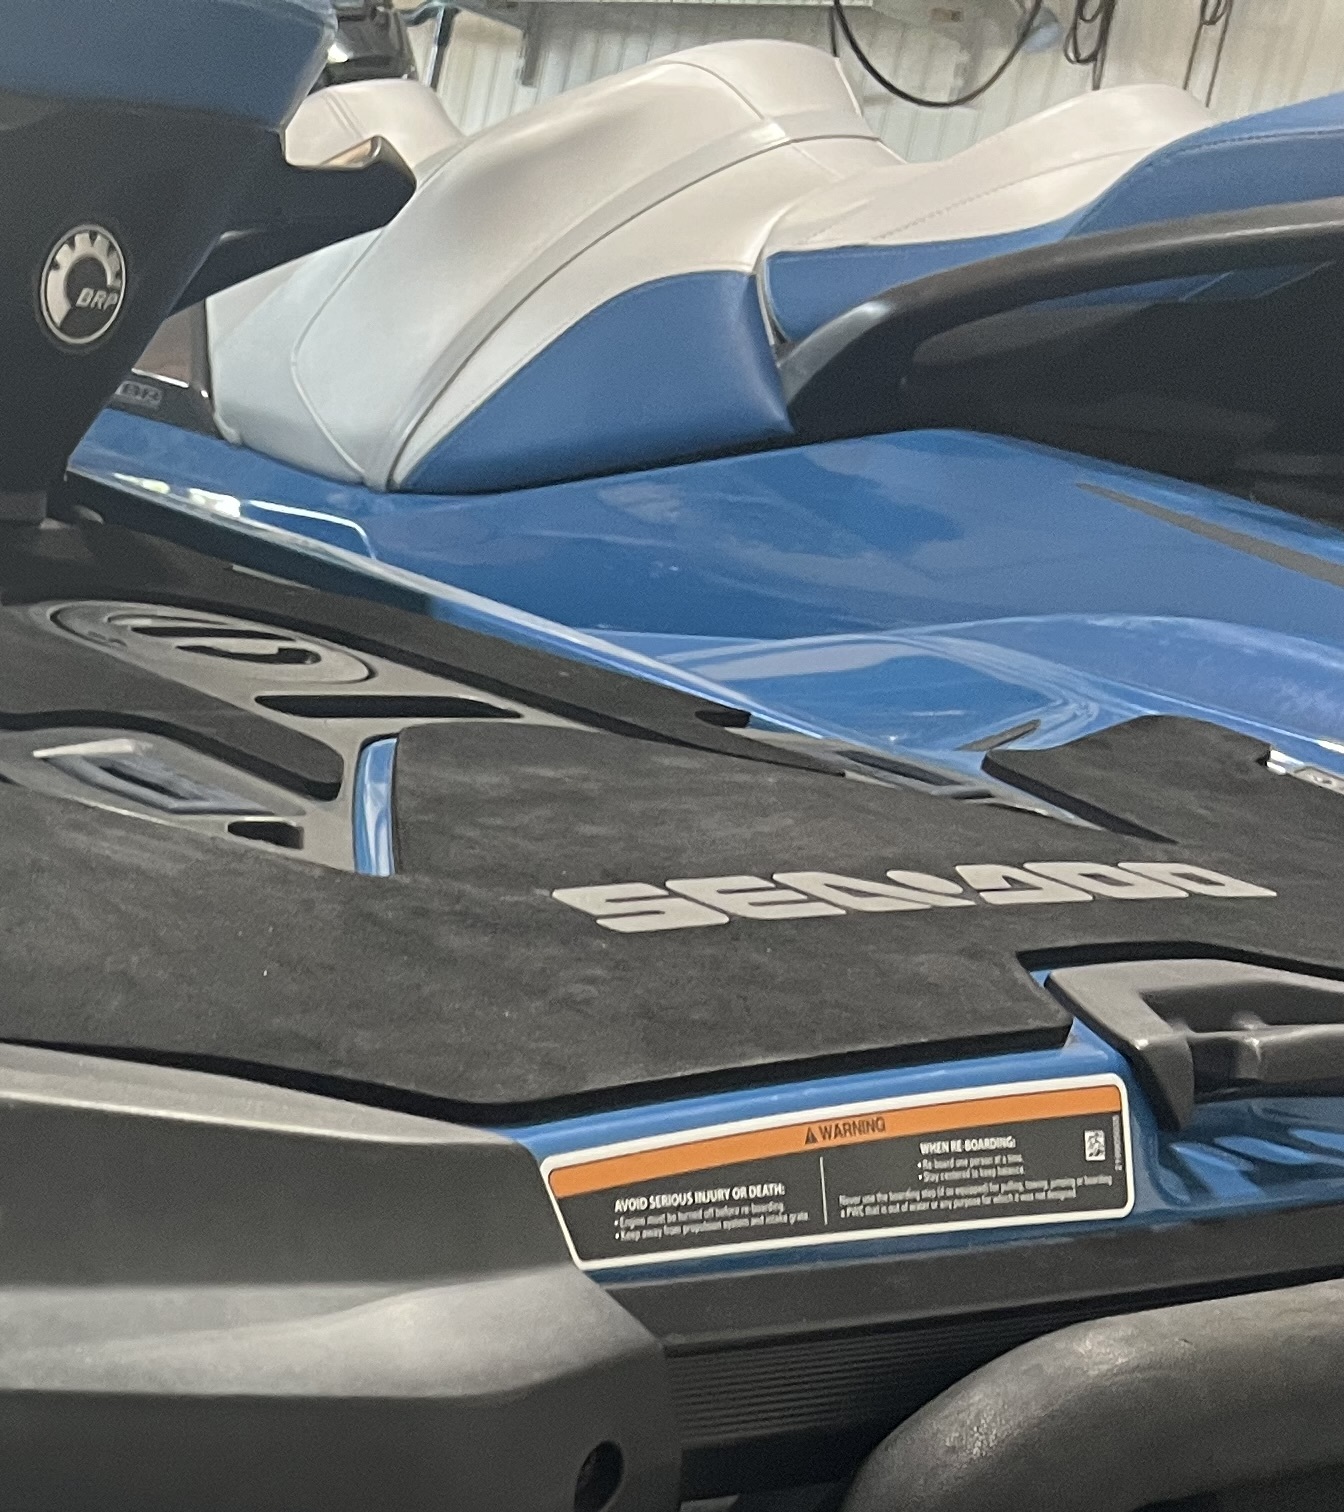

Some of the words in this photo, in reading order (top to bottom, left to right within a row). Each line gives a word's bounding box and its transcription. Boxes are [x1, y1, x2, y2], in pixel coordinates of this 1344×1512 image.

[76, 287, 118, 310] BRP
[819, 1117, 886, 1140] WARNING
[614, 1199, 648, 1213] AVOID
[649, 1191, 693, 1210] SERIOUS
[695, 1188, 730, 1205] INJURY
[732, 1186, 748, 1200] OR
